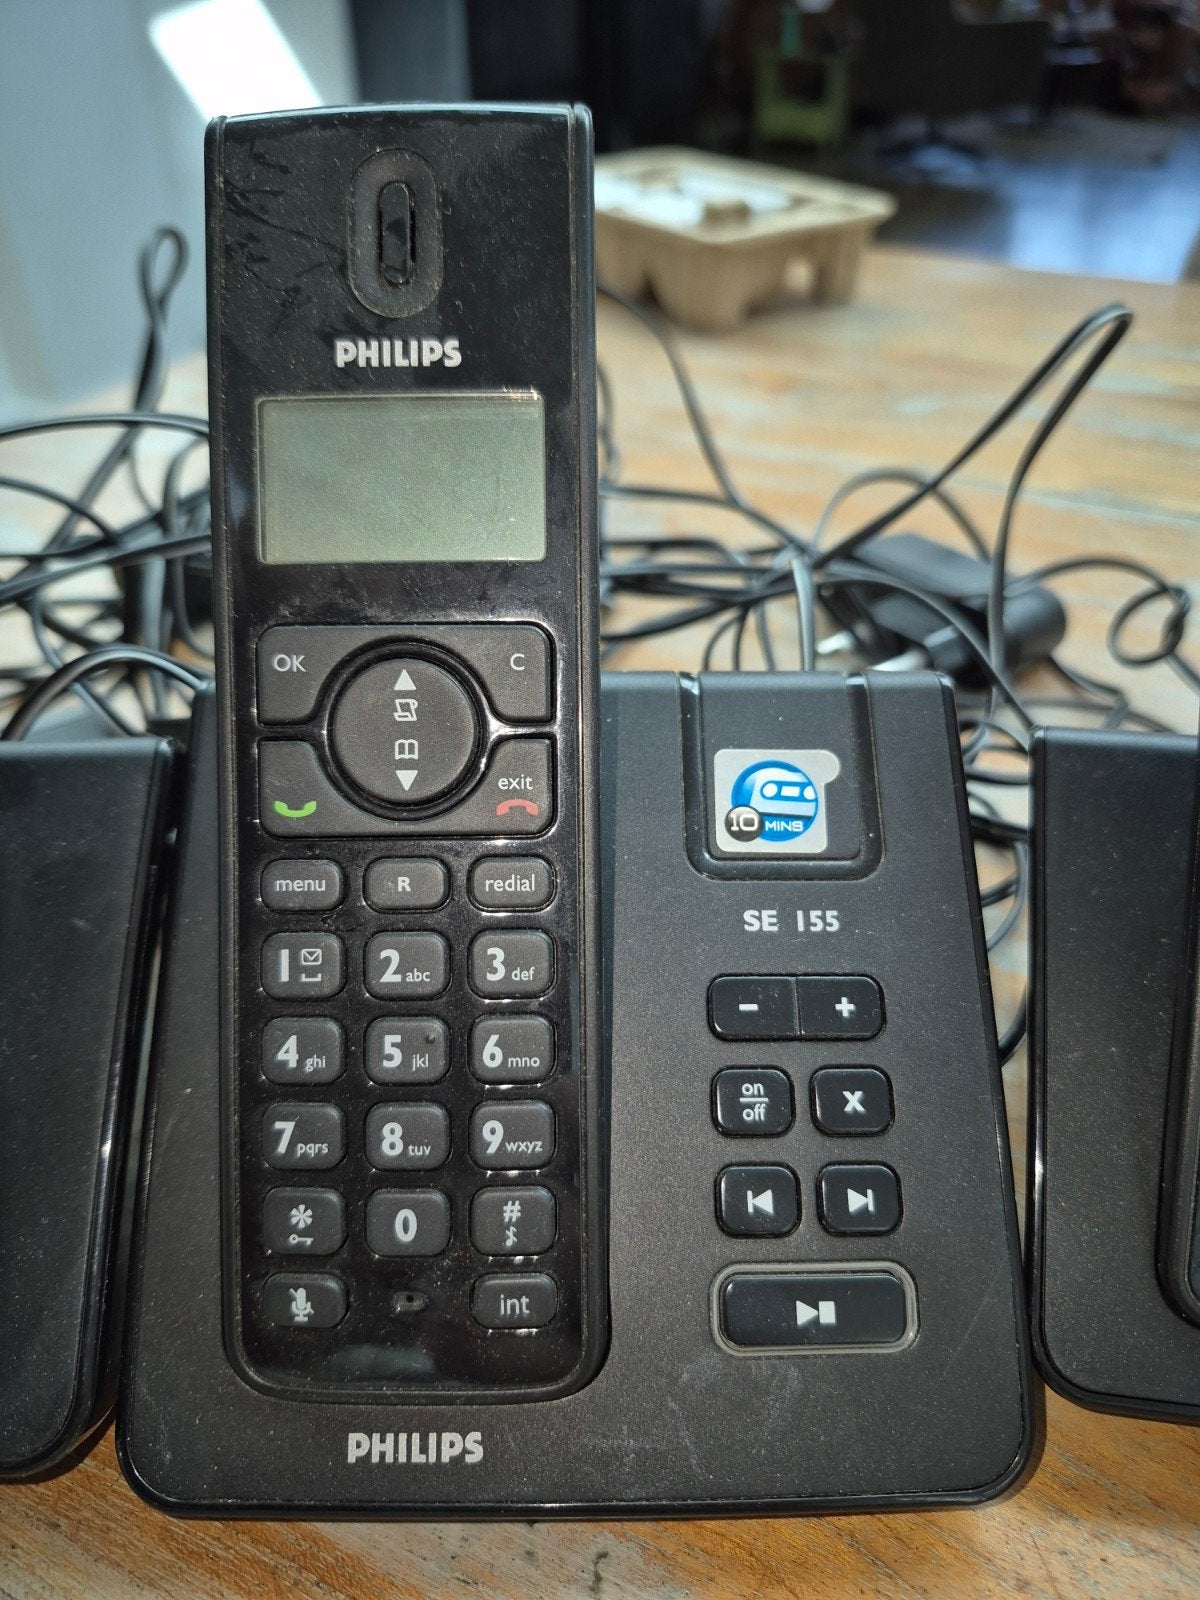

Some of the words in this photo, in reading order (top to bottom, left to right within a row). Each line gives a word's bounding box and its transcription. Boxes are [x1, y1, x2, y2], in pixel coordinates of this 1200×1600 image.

[334, 338, 462, 368] PHILIPS
[273, 654, 306, 673] OK
[510, 654, 525, 671] C
[498, 775, 533, 790] exit
[730, 814, 758, 831] 10
[765, 820, 804, 832] MINS
[275, 877, 326, 892] menu
[397, 877, 411, 892] R
[485, 875, 535, 892] redial
[743, 909, 778, 931] SE
[797, 910, 840, 931] 155
[279, 949, 289, 982] 1
[379, 949, 401, 982] 2
[406, 968, 430, 982] abc
[486, 947, 505, 981] 3
[511, 967, 535, 981] def
[276, 1035, 298, 1068] 4
[305, 1056, 326, 1071] ghi
[382, 1035, 402, 1068] 5
[411, 1054, 429, 1071] jkl
[482, 1035, 503, 1068] 6
[508, 1055, 540, 1068] mno
[741, 1083, 764, 1096] on
[742, 1104, 767, 1121] off
[274, 1121, 296, 1154] 7
[297, 1142, 329, 1157] pqrs
[381, 1122, 404, 1156] 8
[408, 1143, 431, 1156] tuv
[482, 1119, 504, 1154] 9
[505, 1139, 543, 1152] wxyz
[394, 1208, 417, 1242] 0
[500, 1294, 530, 1315] int
[347, 1432, 484, 1463] PHILIPS
